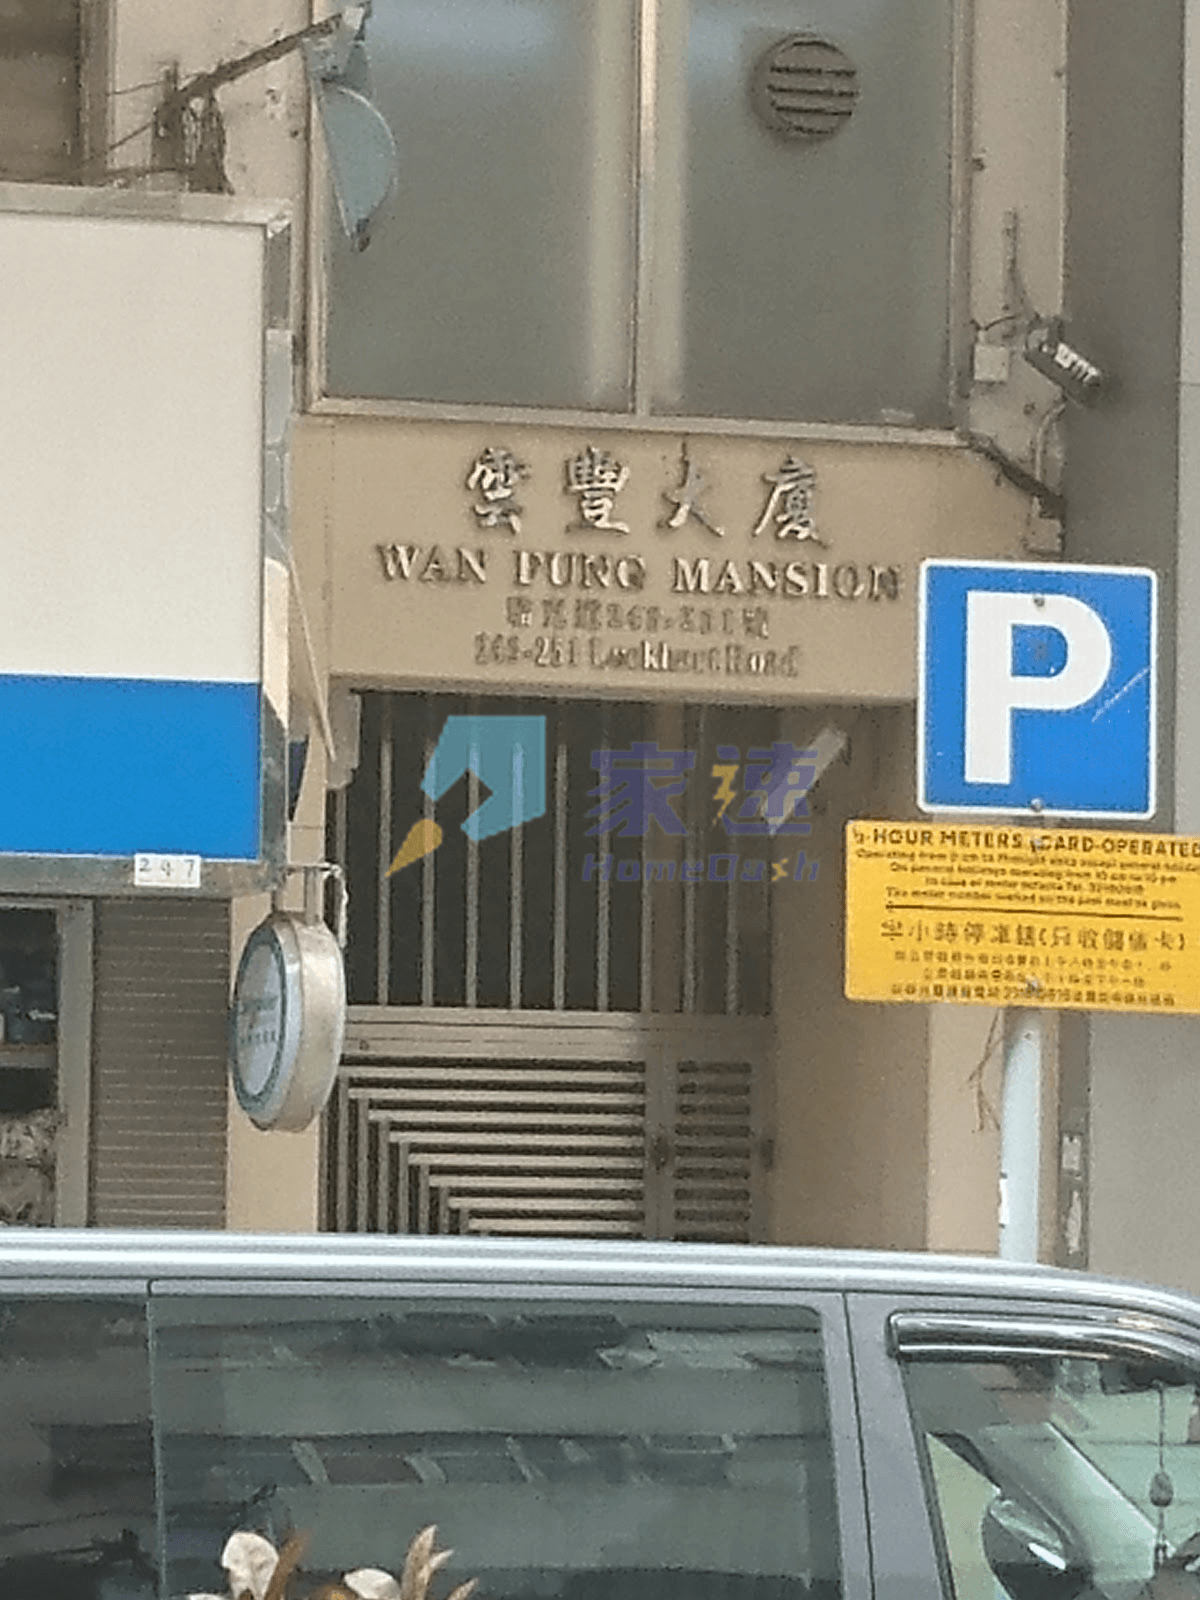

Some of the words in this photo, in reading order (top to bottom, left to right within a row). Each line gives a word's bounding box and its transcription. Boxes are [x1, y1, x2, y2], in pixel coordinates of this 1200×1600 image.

[376, 544, 488, 584] WAN
[672, 556, 898, 601] MANSION
[963, 590, 1112, 785] P
[940, 830, 1023, 849] METERS
[139, 857, 196, 877] 247
